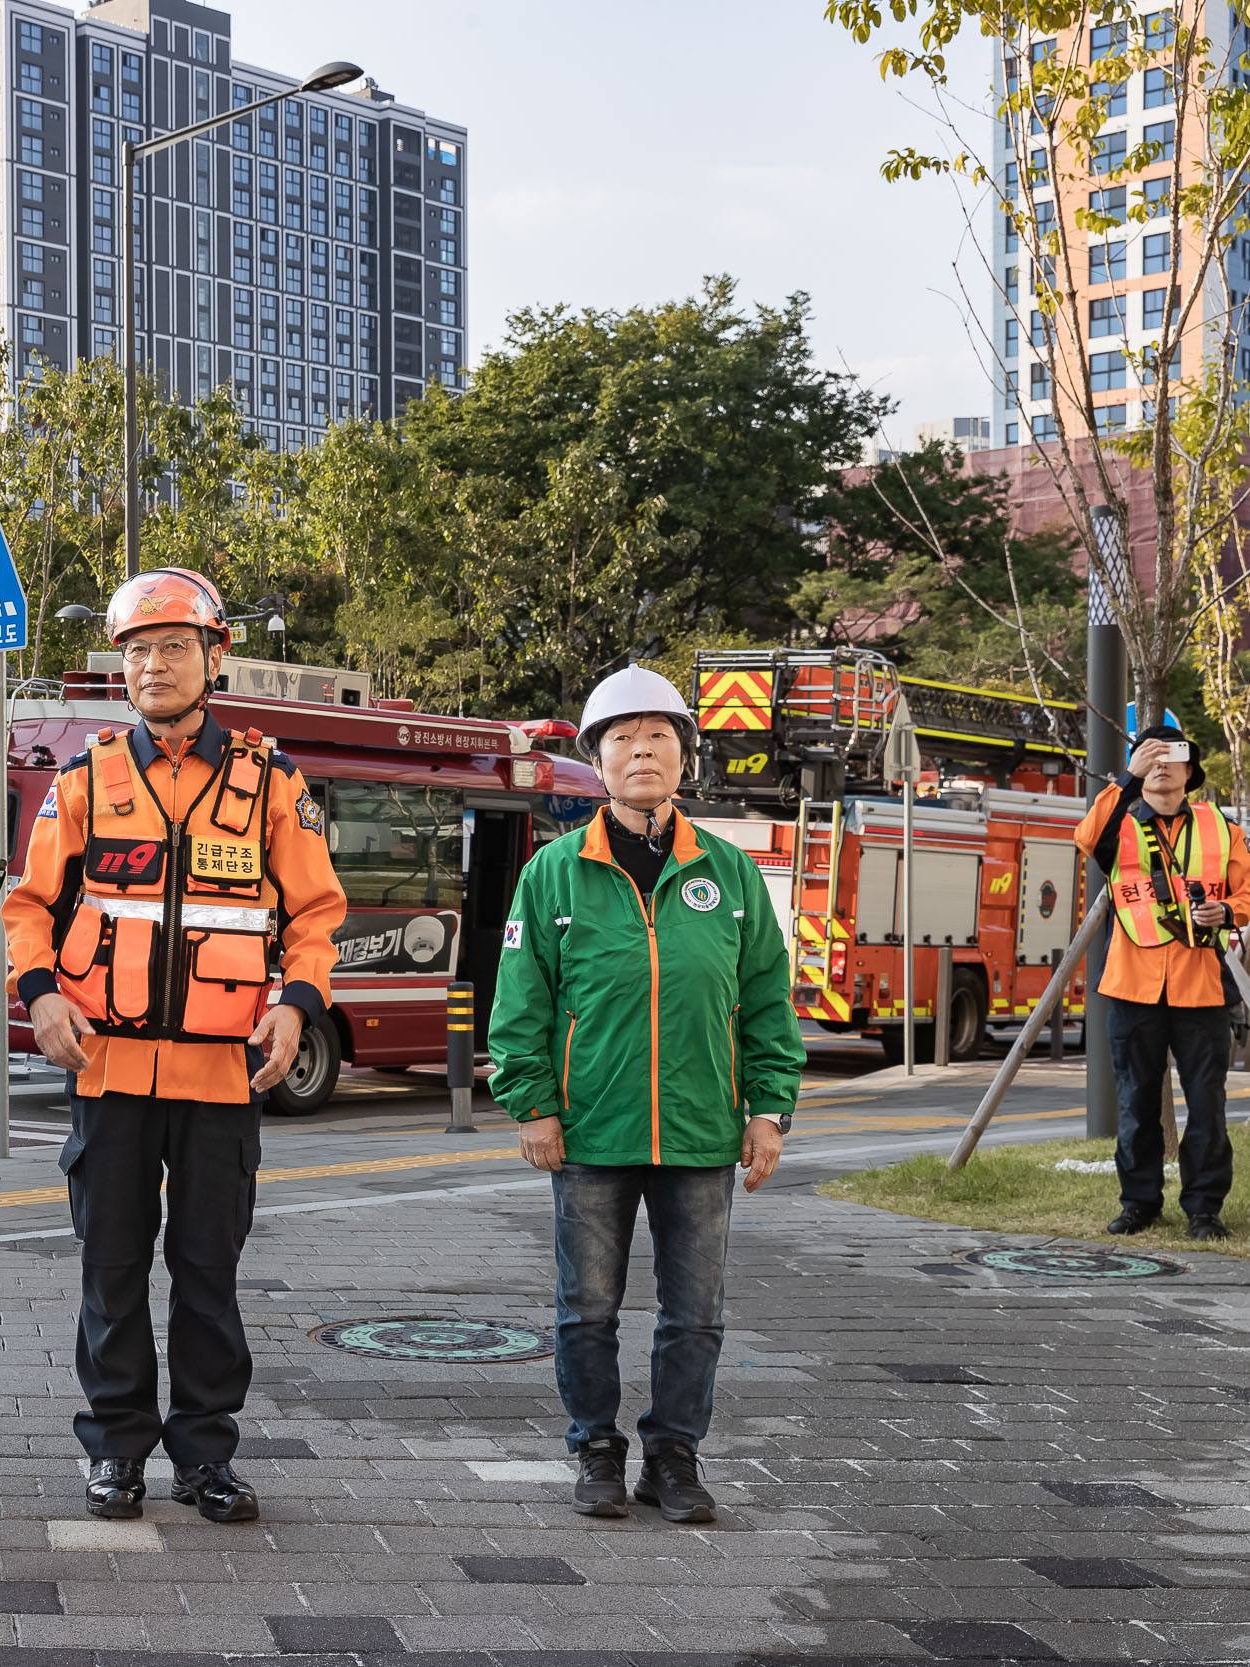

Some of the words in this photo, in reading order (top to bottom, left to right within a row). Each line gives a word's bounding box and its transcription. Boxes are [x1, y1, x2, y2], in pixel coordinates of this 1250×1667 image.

[414, 731, 453, 746] 광진소방서
[726, 753, 769, 774] 119
[95, 842, 157, 875] 119
[197, 843, 253, 859] 긴급구조
[196, 857, 254, 874] 통제단장
[989, 872, 1013, 894] 119
[336, 927, 403, 964] 재경보기
